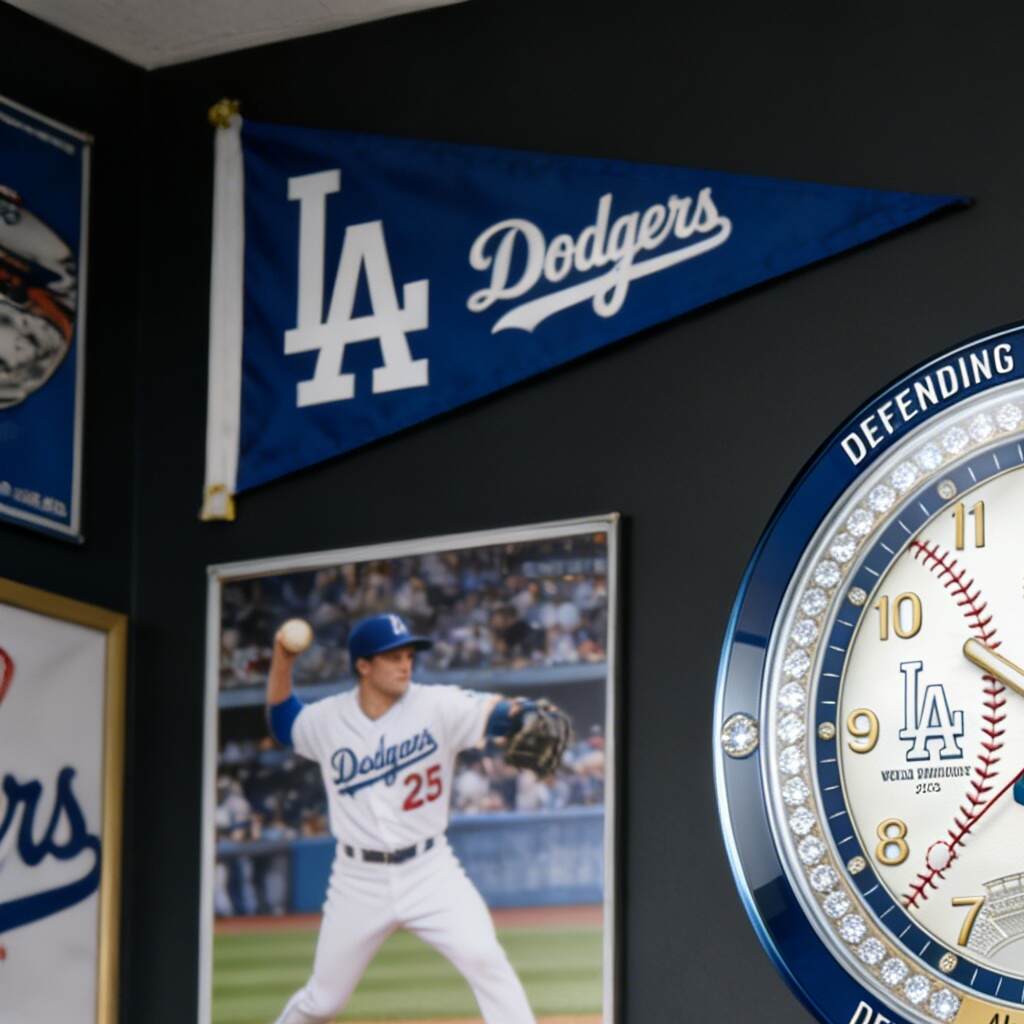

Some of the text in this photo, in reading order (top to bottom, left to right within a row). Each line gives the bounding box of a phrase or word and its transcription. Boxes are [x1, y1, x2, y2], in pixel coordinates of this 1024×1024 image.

[466, 187, 732, 334] Dodgers
[284, 169, 429, 407] LA
[841, 343, 1014, 466] DEFENDING
[951, 500, 985, 550] 11
[874, 591, 923, 641] 10
[847, 708, 880, 754] 9
[899, 660, 964, 762] LA
[402, 764, 443, 812] 25
[875, 818, 910, 866] 8
[952, 896, 985, 948] 7
